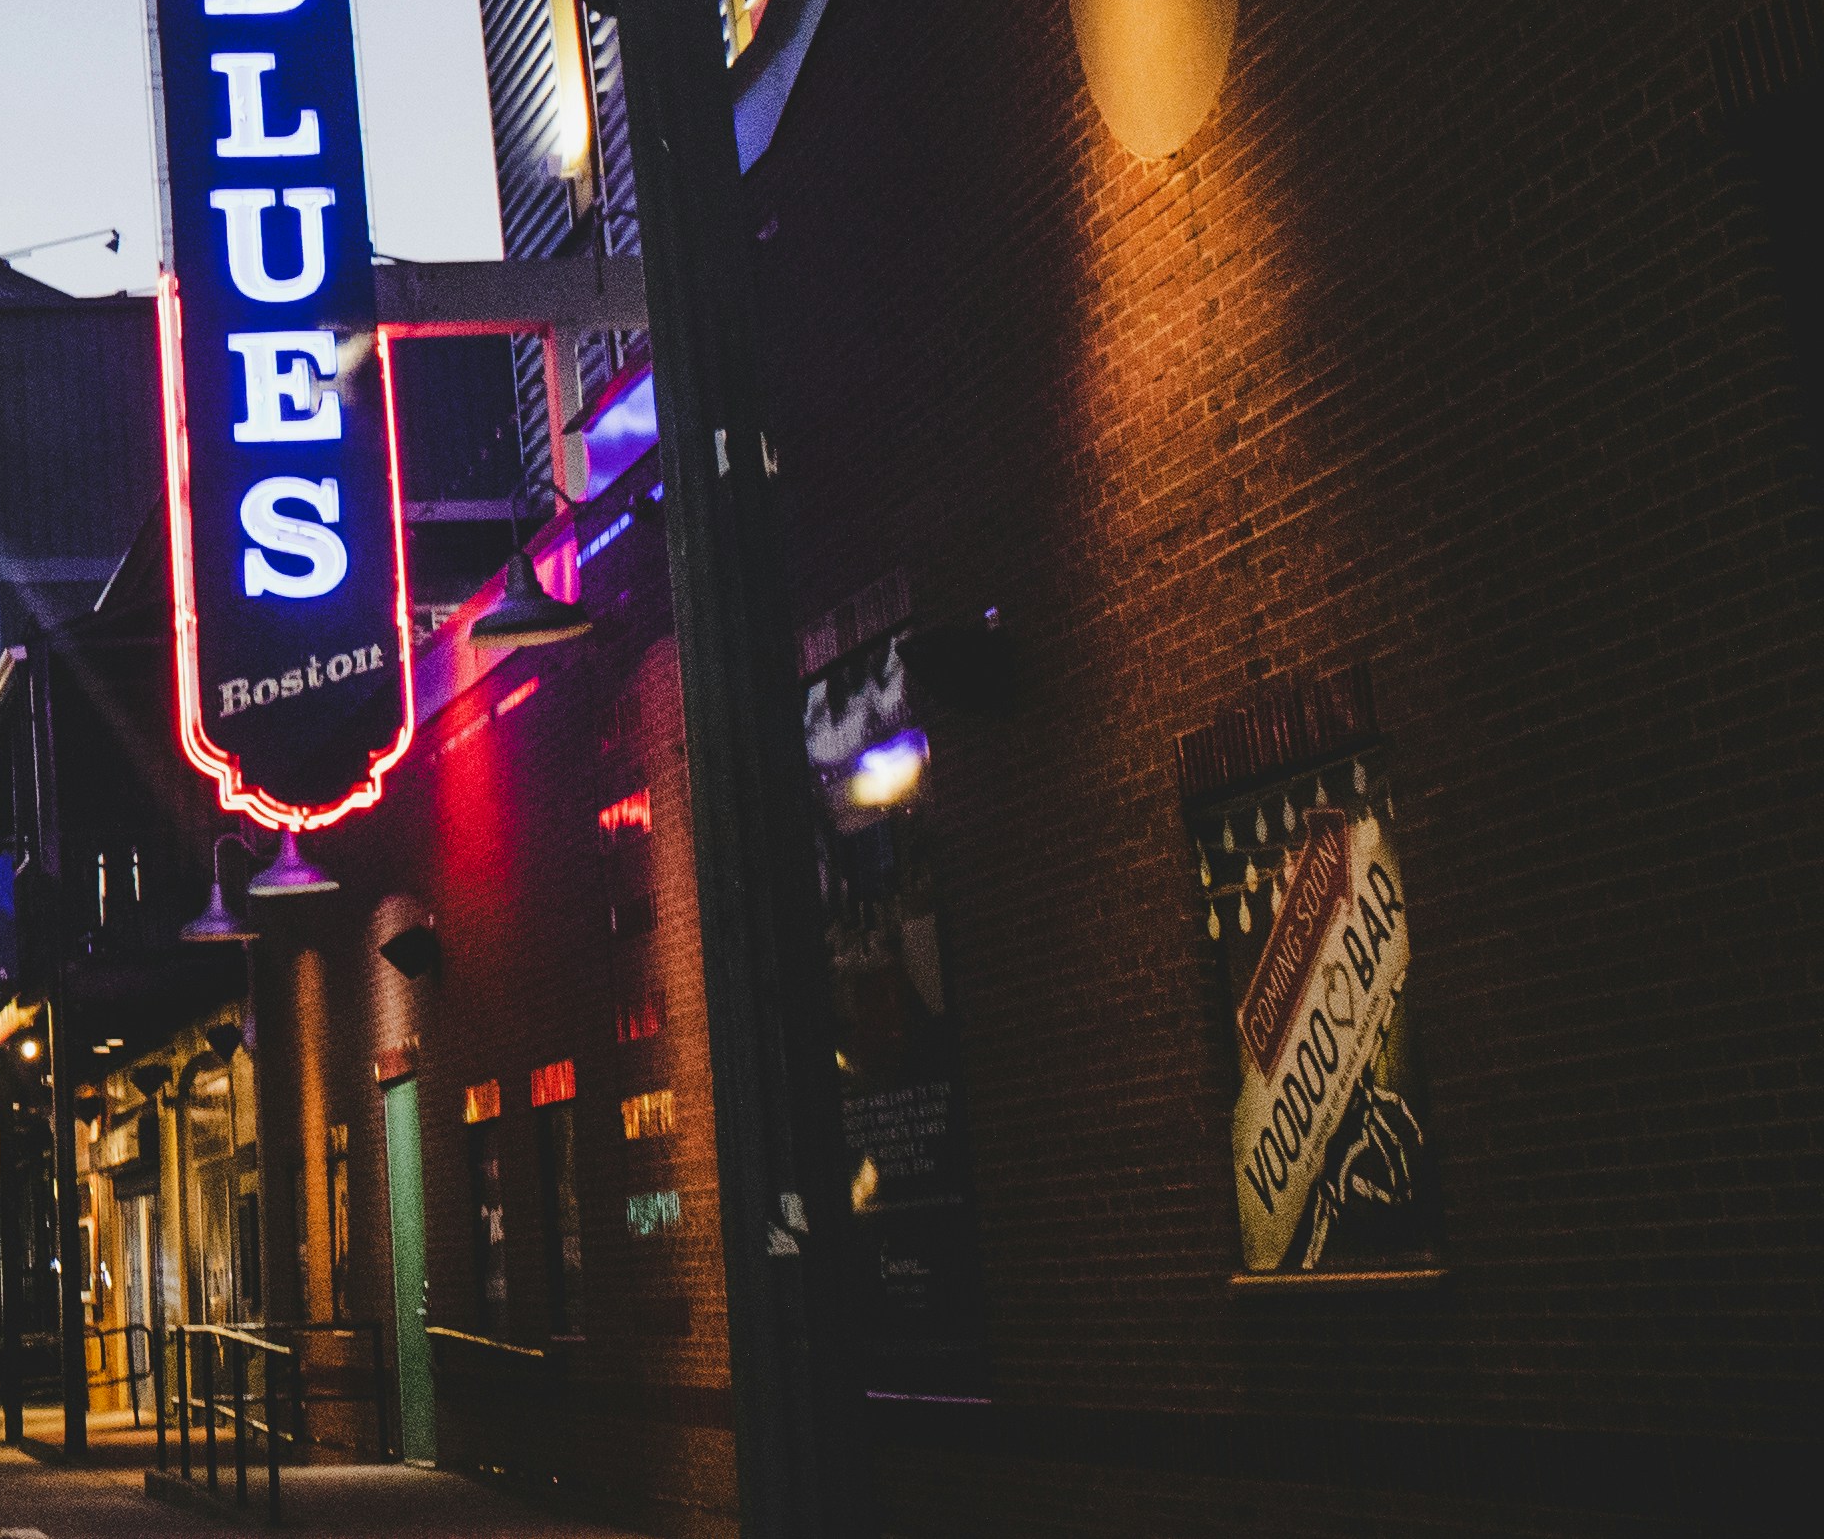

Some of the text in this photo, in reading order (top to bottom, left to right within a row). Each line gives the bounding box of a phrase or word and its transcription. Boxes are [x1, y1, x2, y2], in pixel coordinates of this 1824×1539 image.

[218, 642, 385, 719] Boston
[1244, 862, 1404, 1215] VOODOO BAR
[1249, 827, 1340, 1053] COMING SOON!
